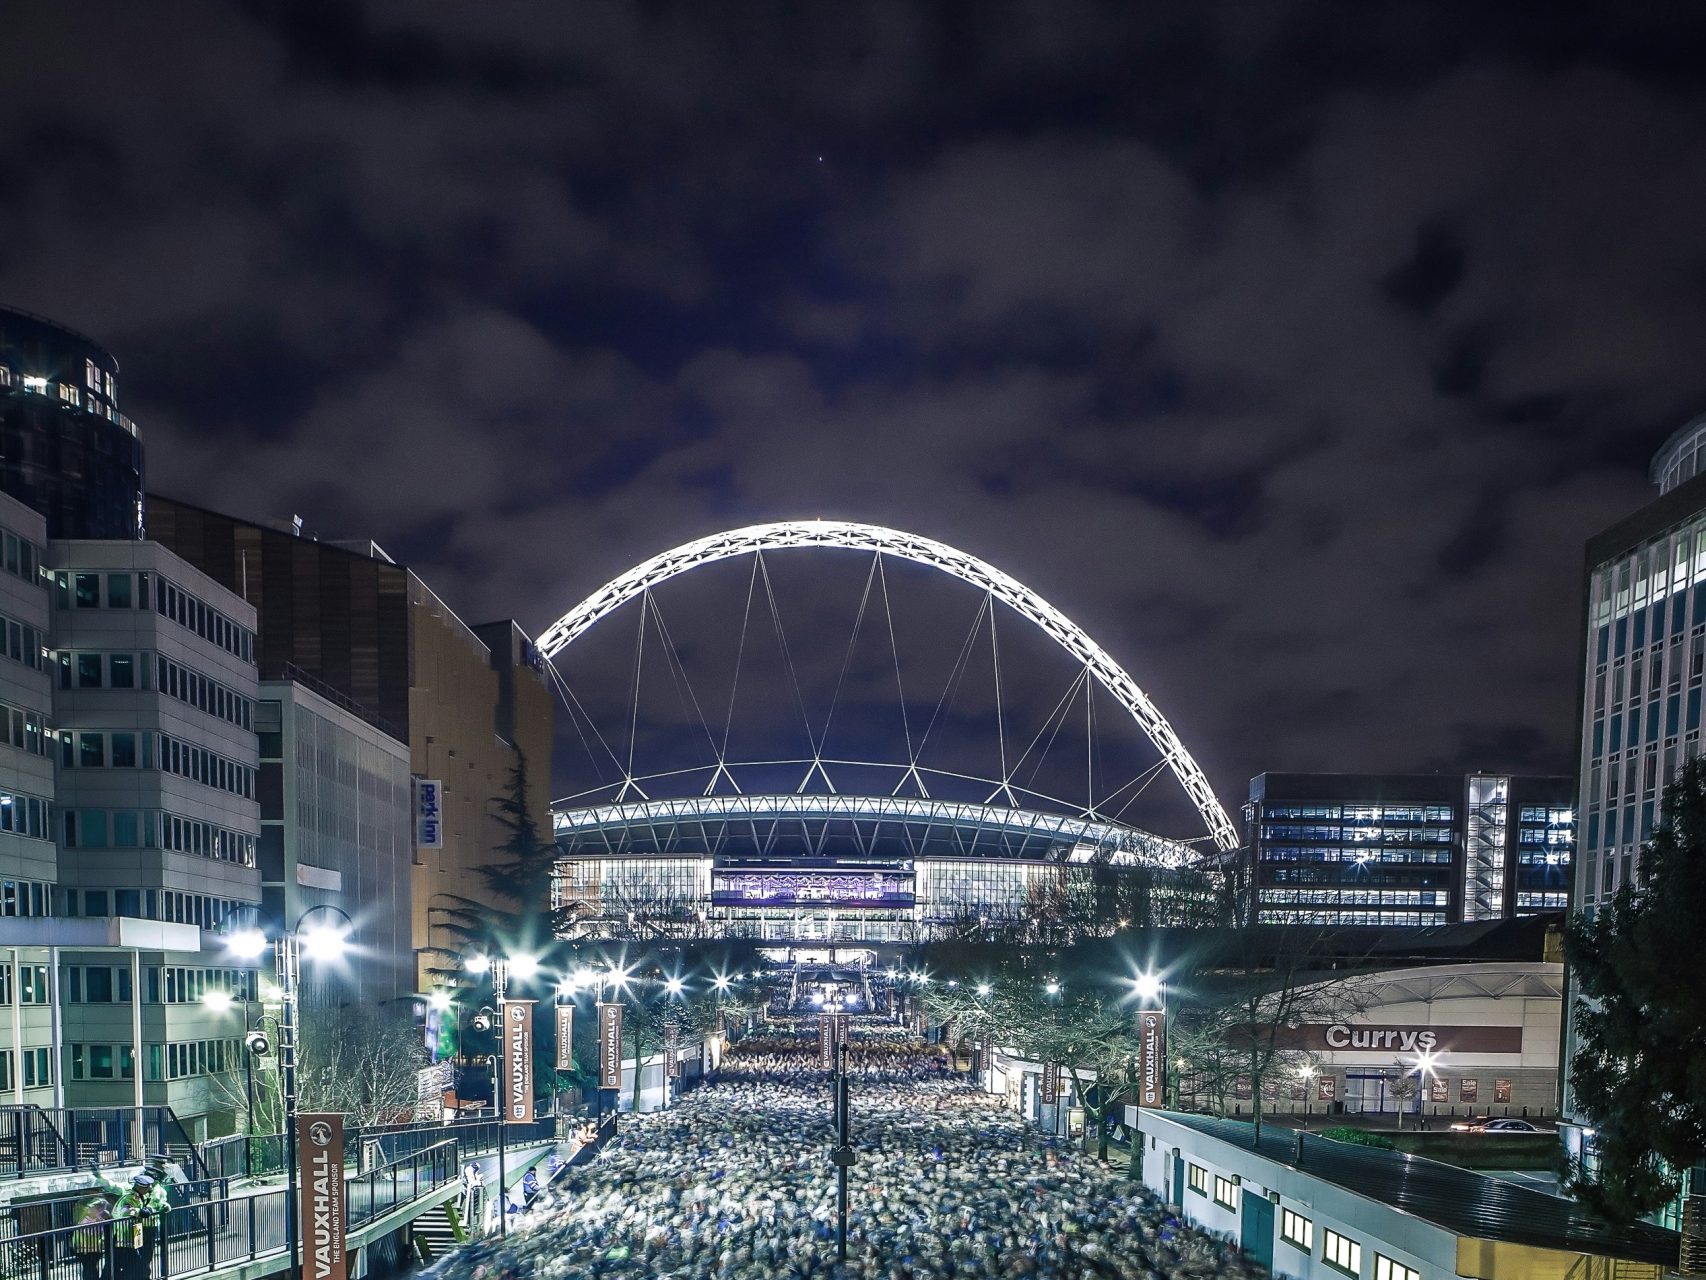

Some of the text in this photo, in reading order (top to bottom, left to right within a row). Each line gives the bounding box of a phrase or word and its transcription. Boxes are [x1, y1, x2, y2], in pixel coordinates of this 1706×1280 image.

[421, 784, 438, 817] park
[512, 1024, 523, 1103] VAUXHALL
[1146, 1029, 1154, 1091] VAUXHALL
[1325, 1025, 1437, 1051] Currys
[313, 1151, 330, 1279] VAUXHALL
